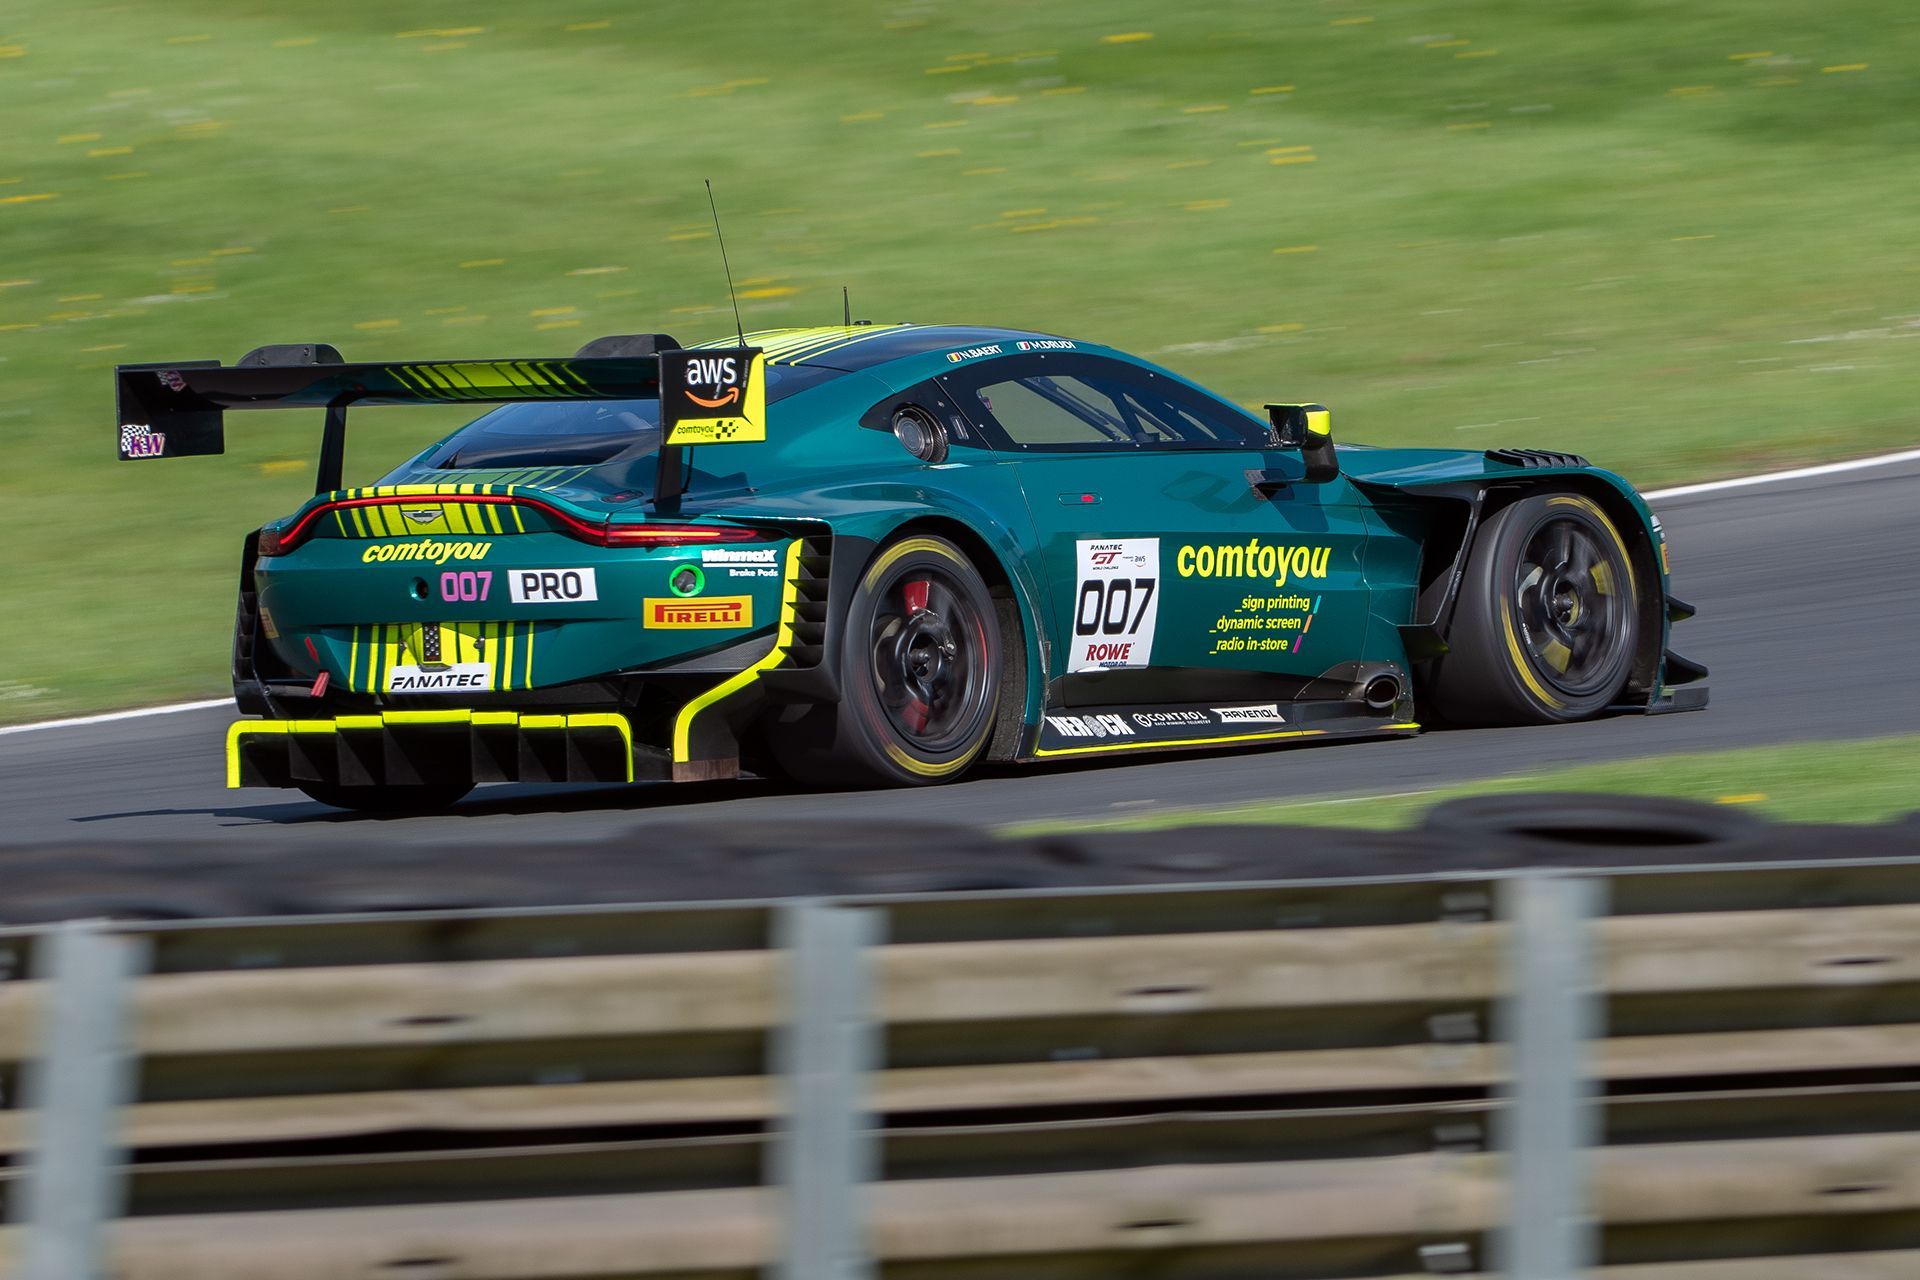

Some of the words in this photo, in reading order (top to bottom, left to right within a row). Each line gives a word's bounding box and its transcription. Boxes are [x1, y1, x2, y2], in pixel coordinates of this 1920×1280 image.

[961, 345, 1003, 360] N.BAERT
[1030, 340, 1076, 350] M.DRUDI
[687, 358, 737, 385] aws
[362, 539, 492, 565] comtoyou
[1177, 538, 1332, 588] comtoyou
[729, 568, 756, 577] Brake
[757, 568, 779, 577] Pads
[440, 571, 493, 602] 007
[521, 571, 583, 600] PRO
[1076, 578, 1156, 636] 007
[1267, 594, 1311, 612] printing
[655, 602, 742, 623] PIRELLI
[1265, 617, 1301, 629] screen
[1085, 643, 1132, 661] ROWE
[1246, 636, 1288, 651] in-store
[390, 673, 485, 690] FANATEC
[1147, 711, 1208, 722] CONTROL
[1223, 708, 1278, 720] RAVENOL
